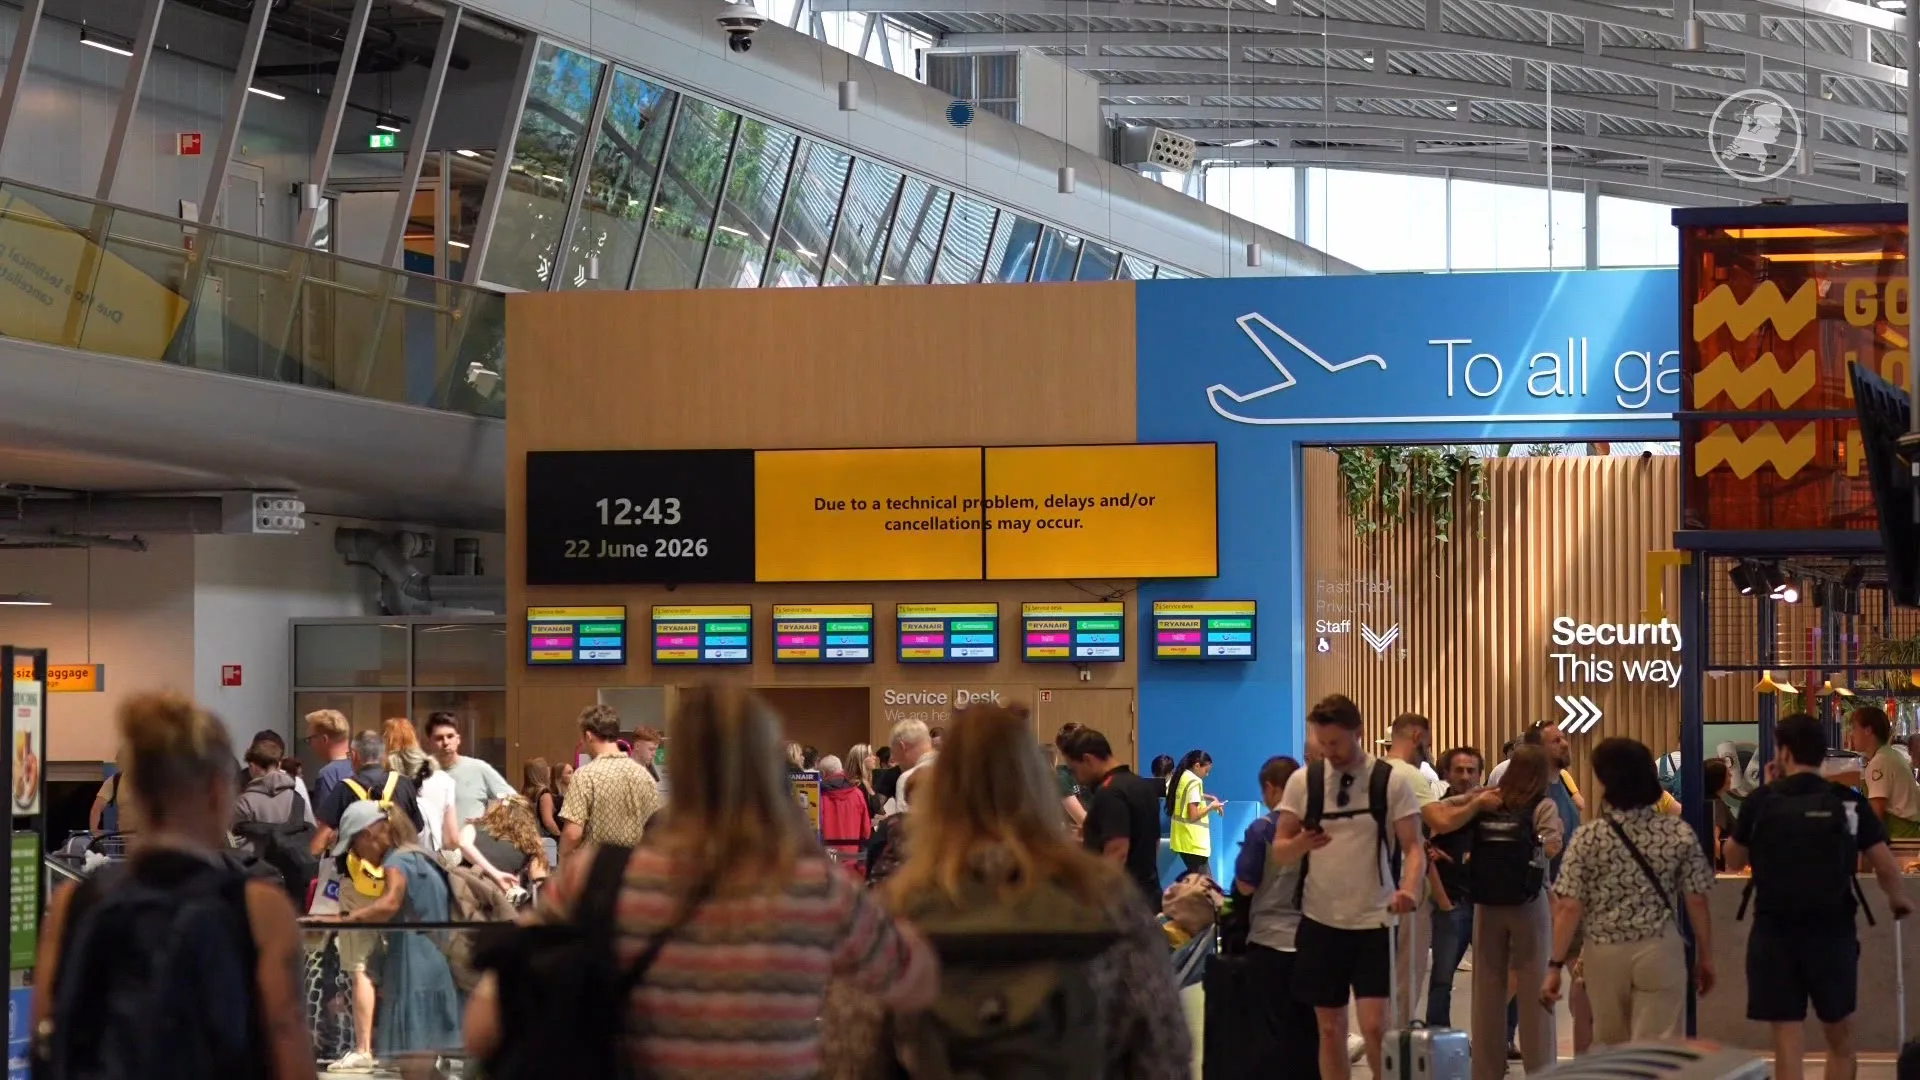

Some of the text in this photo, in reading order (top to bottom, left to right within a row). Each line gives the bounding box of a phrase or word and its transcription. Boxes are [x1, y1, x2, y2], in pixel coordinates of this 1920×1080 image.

[1844, 278, 1910, 327] GO
[1428, 336, 1681, 410] To all ga
[596, 497, 682, 526] 12:43
[814, 493, 1156, 513] Due to a technical problem, delays and/or
[885, 516, 1084, 534] cancellations may occur.
[564, 538, 709, 558] 22 June 2026
[1316, 579, 1351, 593] Fast
[1315, 619, 1352, 633] Staff
[1551, 616, 1683, 652] Security
[48, 669, 89, 680] aggage
[1550, 653, 1683, 689] This way
[884, 689, 1001, 705] Service Desk
[884, 708, 906, 721] We
[910, 710, 929, 721] are
[789, 773, 815, 781] ANAIR
